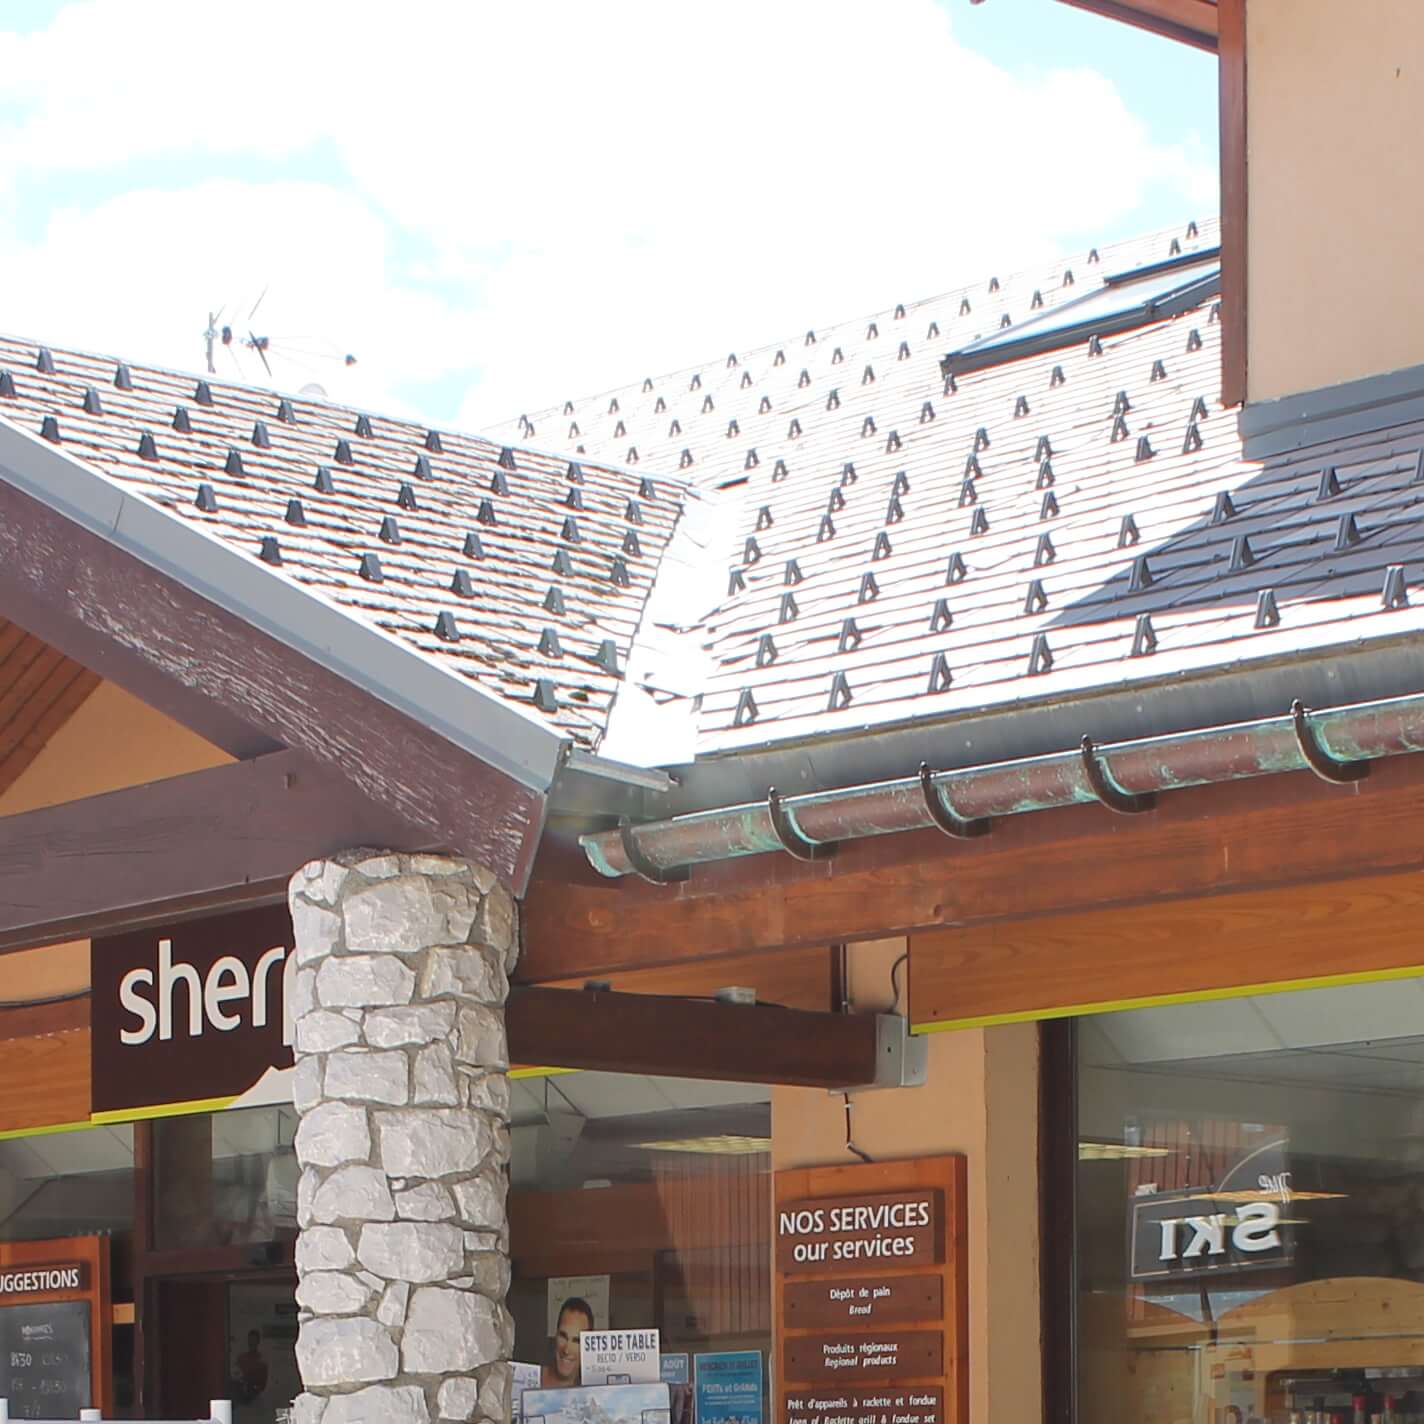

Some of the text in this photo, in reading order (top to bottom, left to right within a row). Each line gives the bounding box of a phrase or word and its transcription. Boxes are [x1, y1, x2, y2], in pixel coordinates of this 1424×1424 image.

[119, 939, 297, 1046] sher
[779, 1202, 929, 1235] NOS SERVICES
[794, 1234, 914, 1262] our services
[830, 1286, 890, 1300] Dépôt de pain
[849, 1304, 872, 1315] Bread
[584, 1333, 656, 1351] SETS DE TABLE
[823, 1342, 898, 1354] Produits régionaux
[625, 1352, 646, 1362] VERSO
[825, 1355, 896, 1369] Regional products
[787, 1399, 803, 1410] Prêt
[808, 1398, 848, 1411] d'appareils
[862, 1396, 891, 1407] raclette
[895, 1397, 904, 1407] et
[909, 1394, 937, 1406] fondue
[892, 1414, 920, 1424] fondue
[924, 1414, 935, 1424] set
